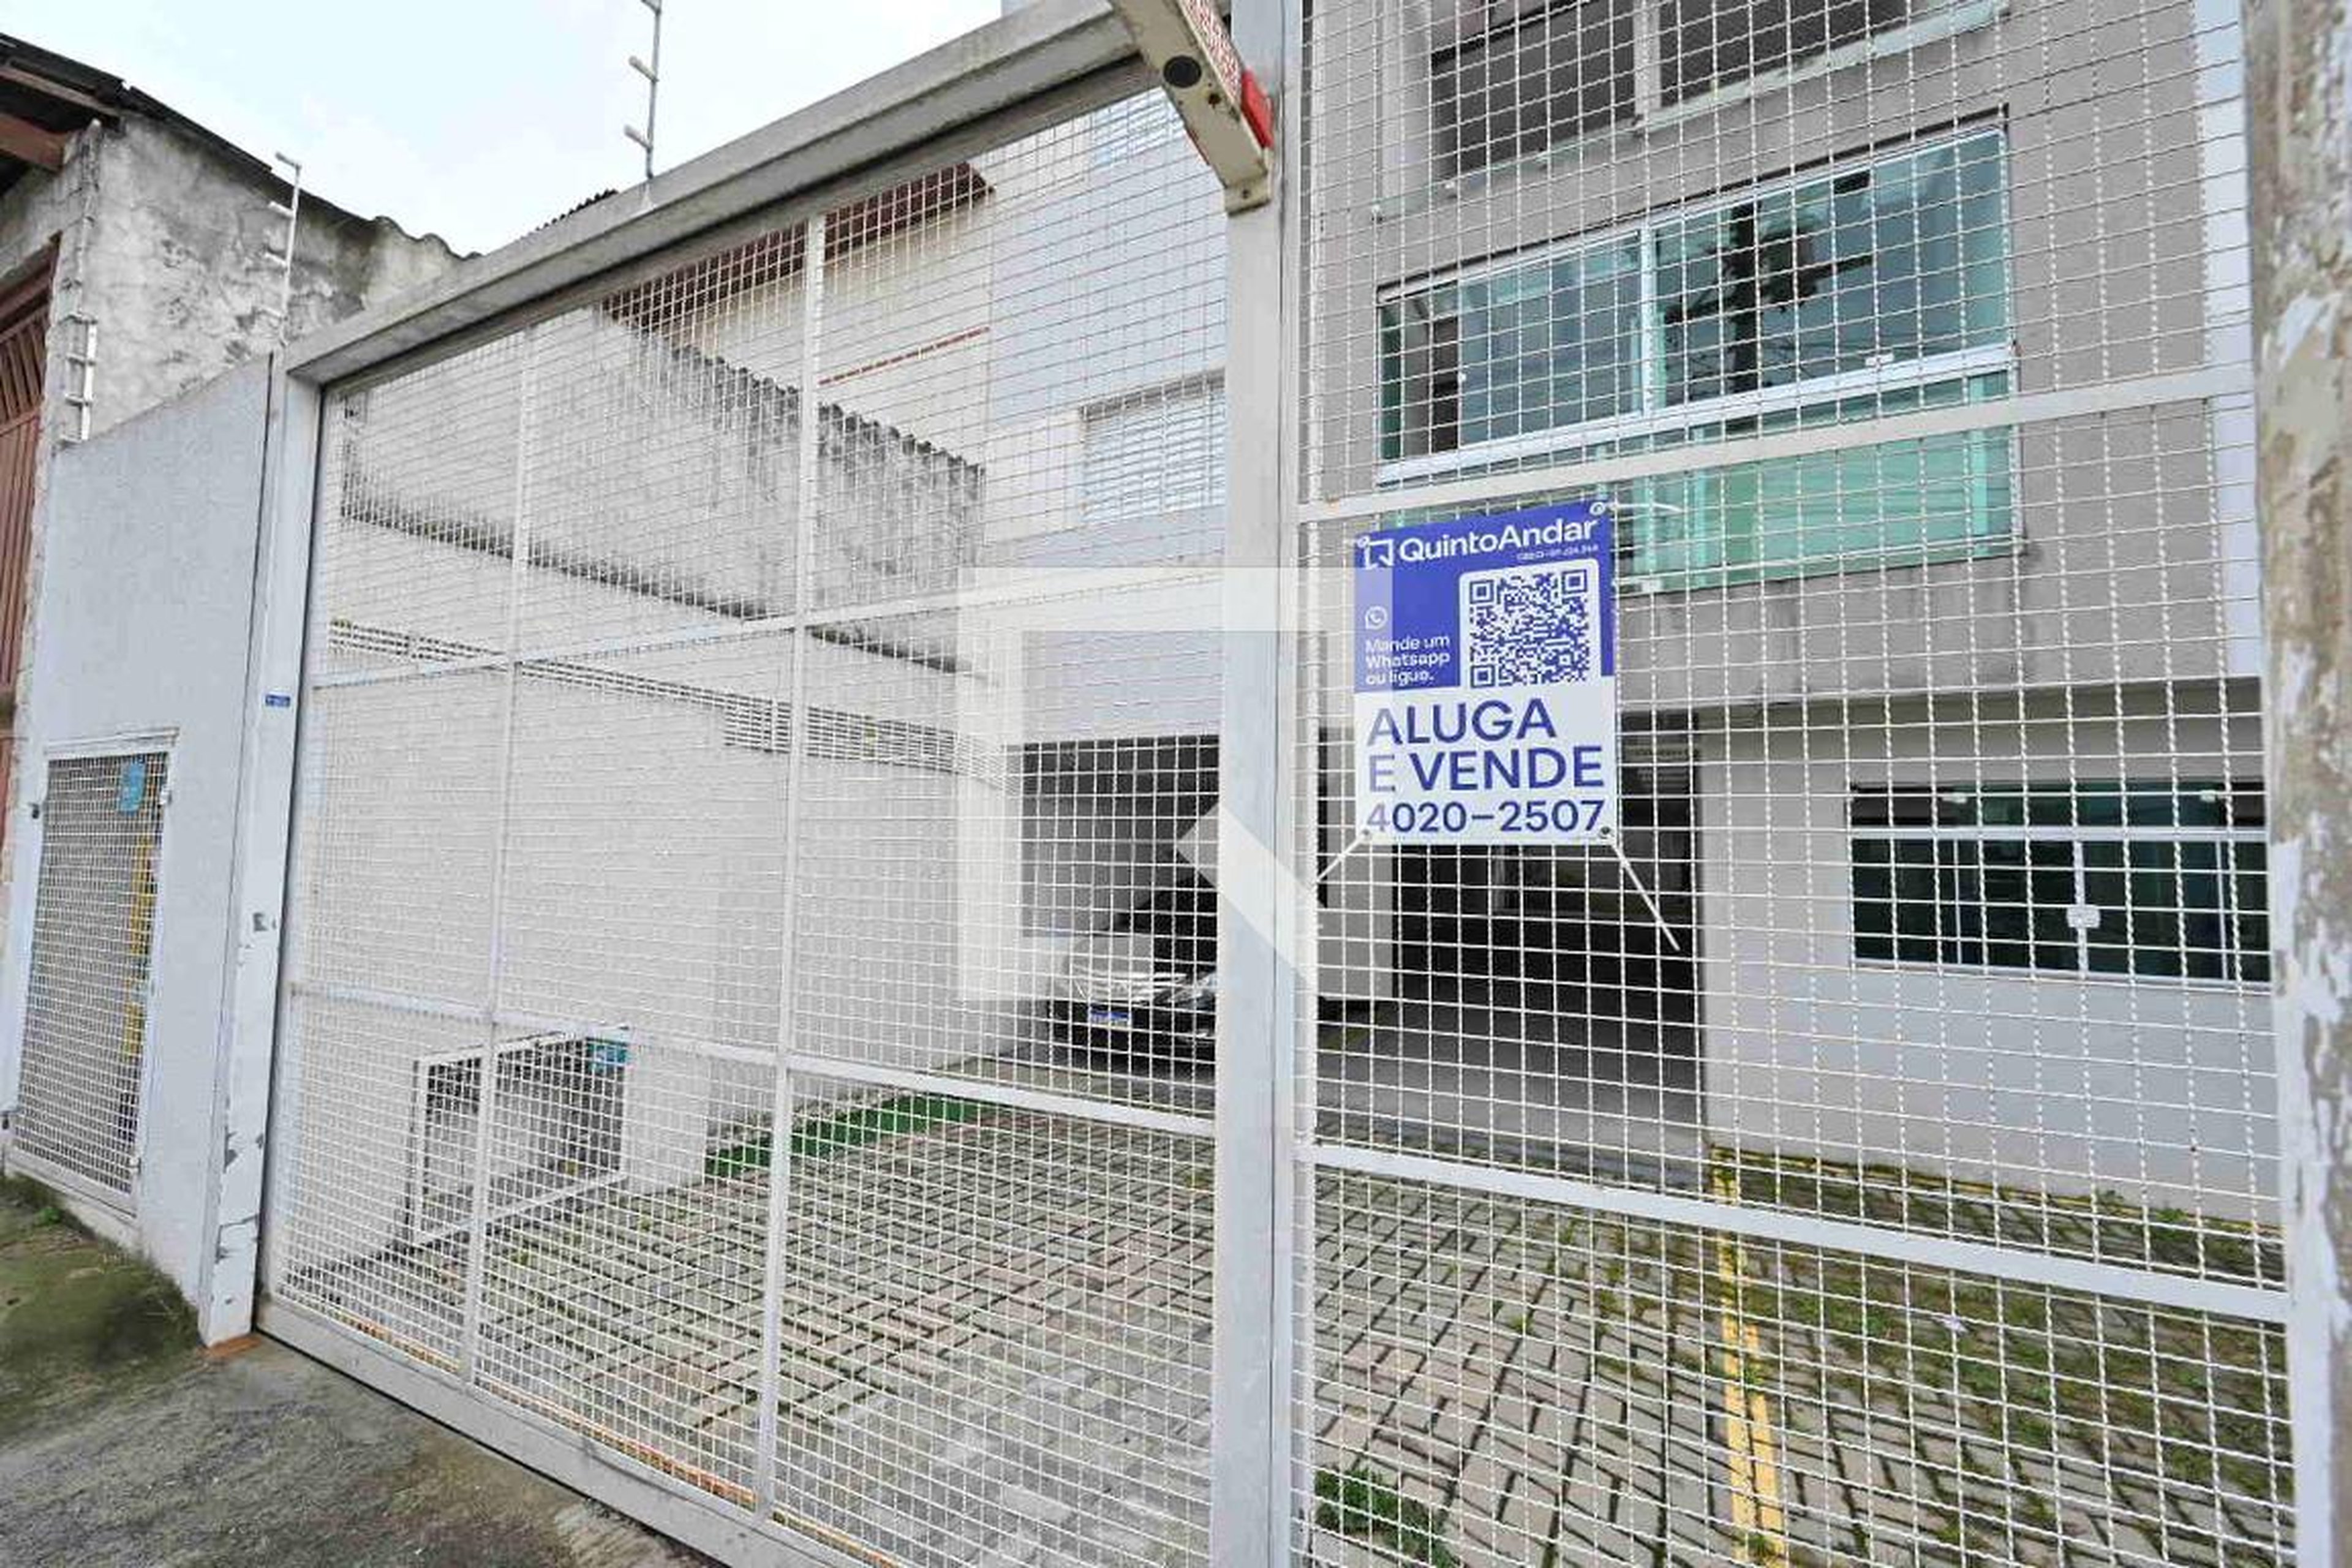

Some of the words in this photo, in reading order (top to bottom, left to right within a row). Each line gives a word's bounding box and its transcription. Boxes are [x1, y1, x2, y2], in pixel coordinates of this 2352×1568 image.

[1400, 518, 1597, 562] QuintoAndar
[1365, 636, 1420, 652] Mande
[1423, 636, 1450, 649] um
[1365, 652, 1451, 668] Whatsapp
[1365, 674, 1386, 685] ou
[1366, 698, 1557, 746] ALUGA
[1369, 755, 1396, 793] E
[1408, 745, 1605, 791] VENDE
[1367, 799, 1605, 833] 4020-2507
